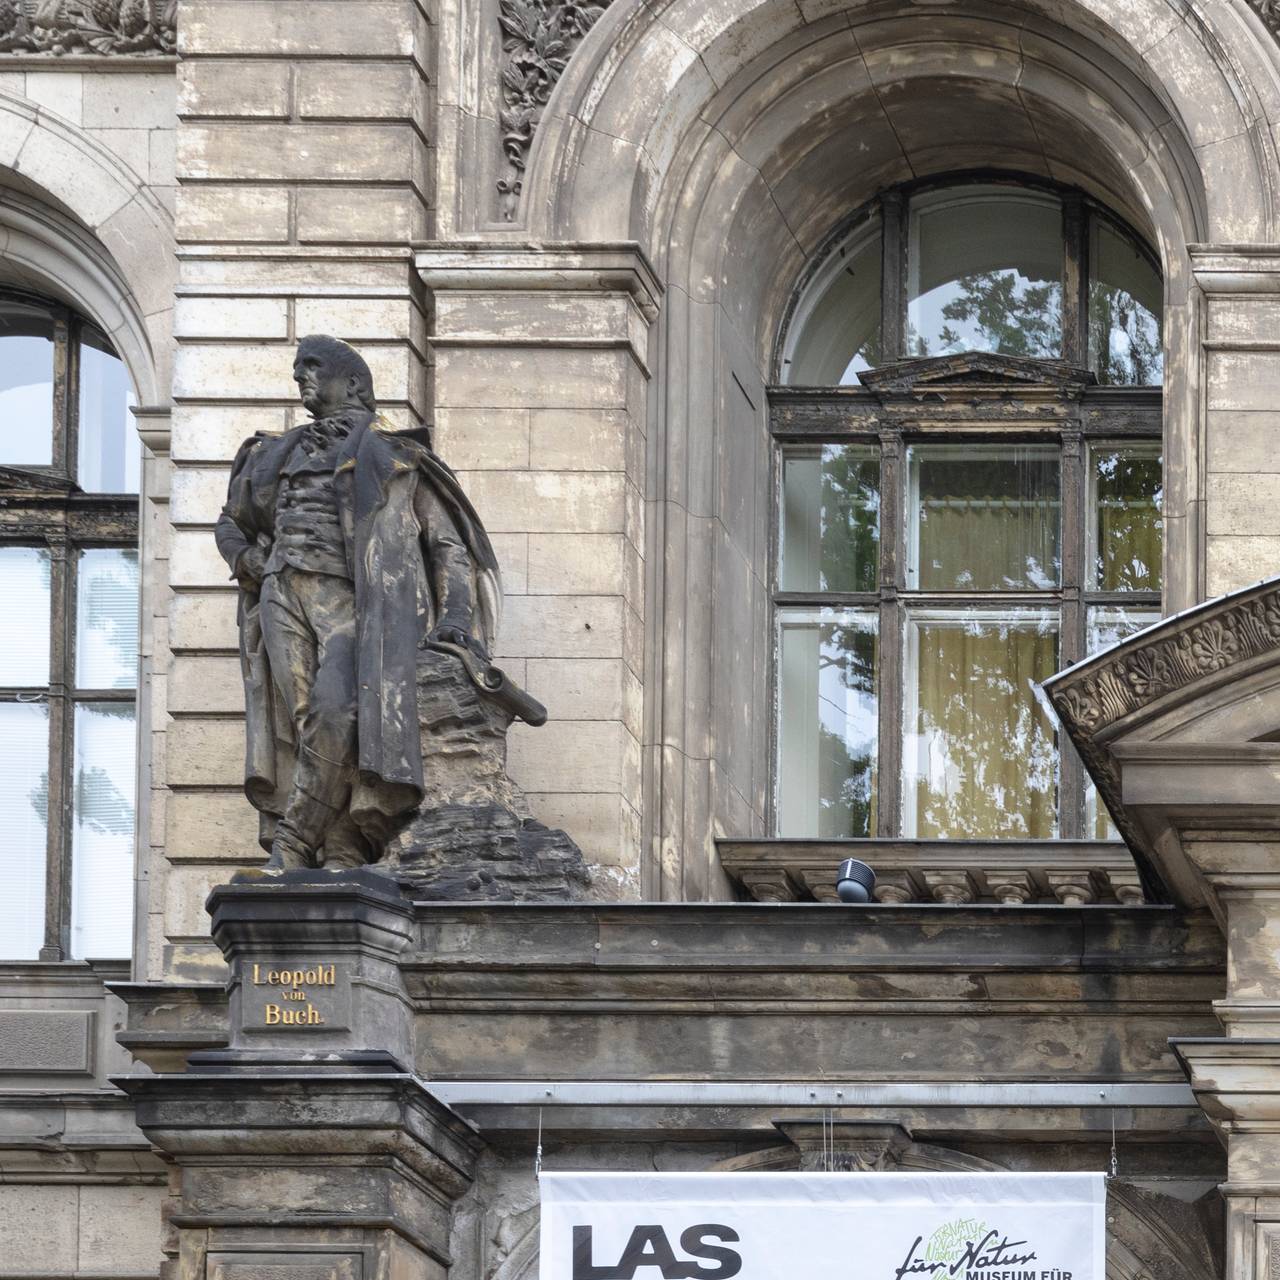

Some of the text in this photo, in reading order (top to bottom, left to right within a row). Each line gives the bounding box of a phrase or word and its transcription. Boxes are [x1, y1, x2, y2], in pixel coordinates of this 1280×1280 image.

[253, 964, 335, 989] Leopold
[282, 991, 305, 1001] von
[572, 1223, 742, 1280] LAS
[950, 1229, 1038, 1275] Natur
